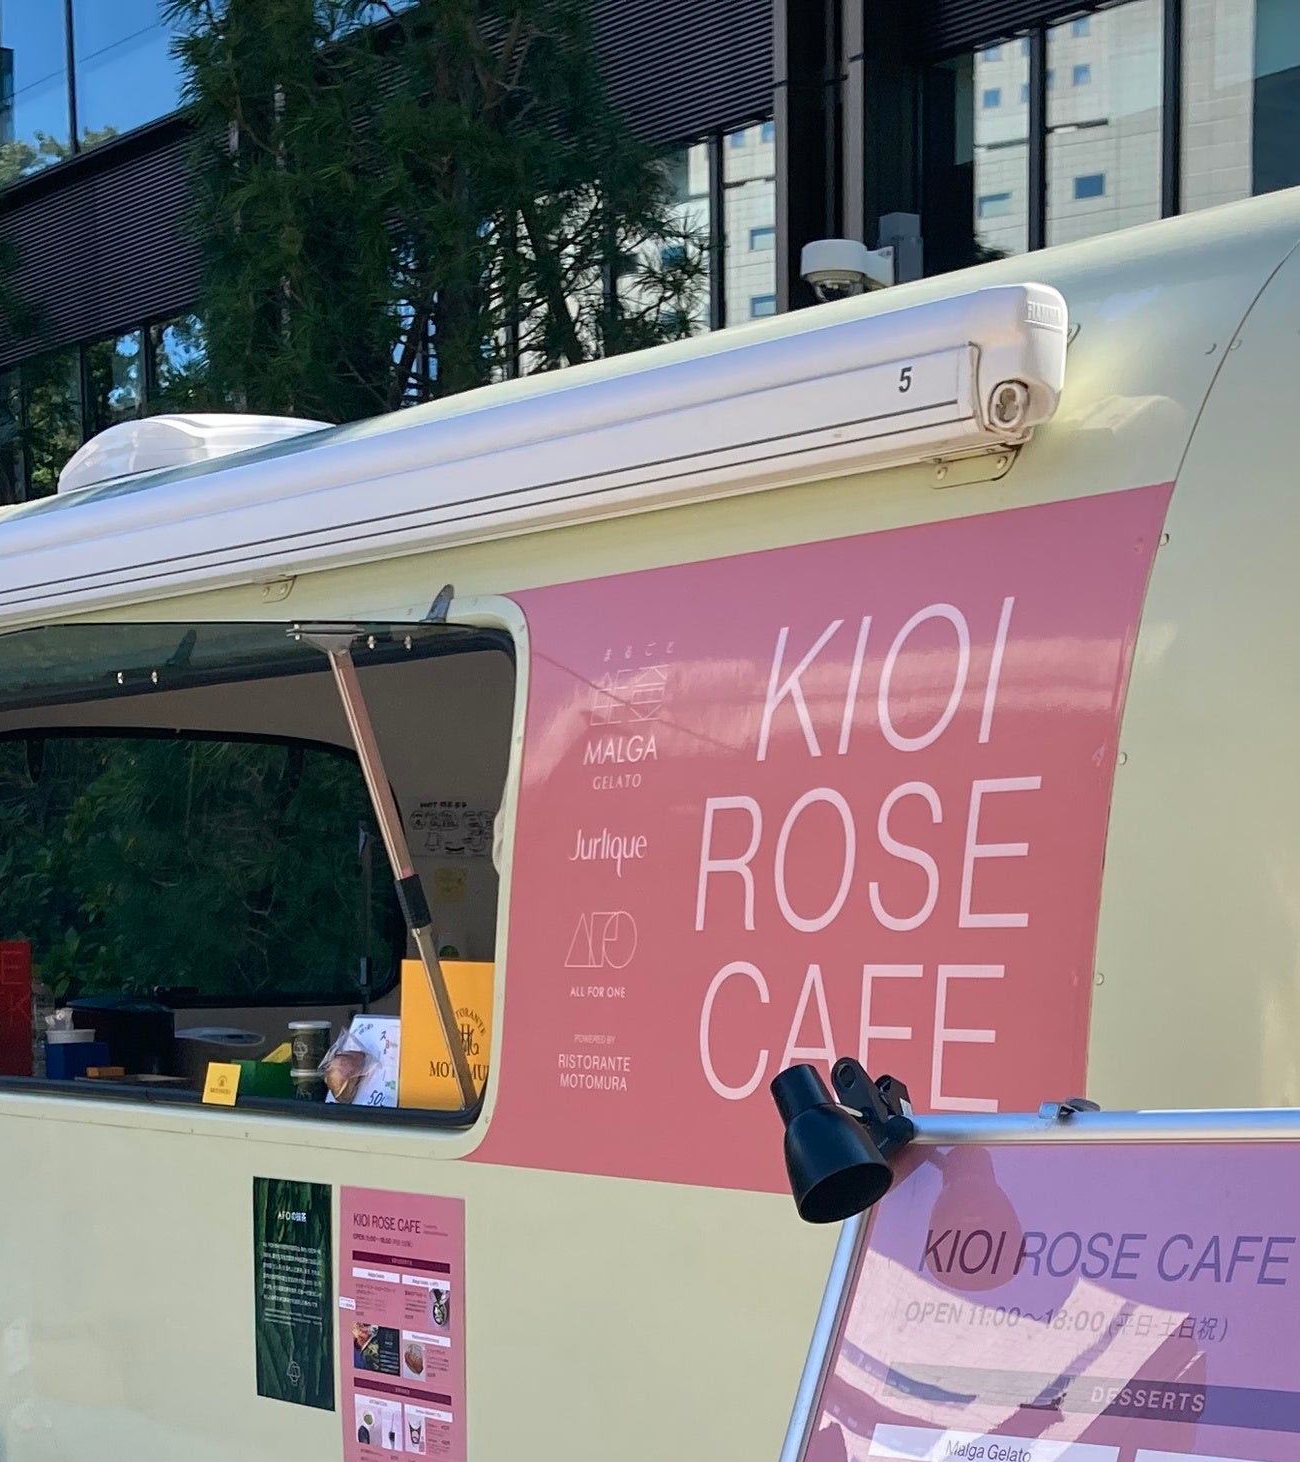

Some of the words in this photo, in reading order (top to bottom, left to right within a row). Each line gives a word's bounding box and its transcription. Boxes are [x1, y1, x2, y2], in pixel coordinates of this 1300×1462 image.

[898, 365, 913, 393] 5
[756, 596, 1014, 762] KIOI
[583, 734, 657, 765] MALGA
[592, 773, 642, 791] GELATO
[569, 828, 648, 878] Jurlique
[695, 776, 1042, 933] ROSE
[570, 985, 585, 998] ALL
[587, 985, 605, 998] FOR
[606, 986, 626, 998] ONE
[700, 961, 1006, 1113] CAFE
[558, 1053, 631, 1072] RISTORANTE
[560, 1073, 628, 1092] MOTOMURA
[352, 1212, 371, 1228] KIOI
[371, 1215, 397, 1231] ROSE
[397, 1218, 422, 1234] CAFE
[918, 1229, 1007, 1275] KIOI
[1012, 1231, 1148, 1280] ROSE
[1156, 1233, 1297, 1286] CAFE
[904, 1301, 964, 1324] OPEN
[1090, 1386, 1206, 1413] DESSERTS
[945, 1439, 984, 1460] Malga
